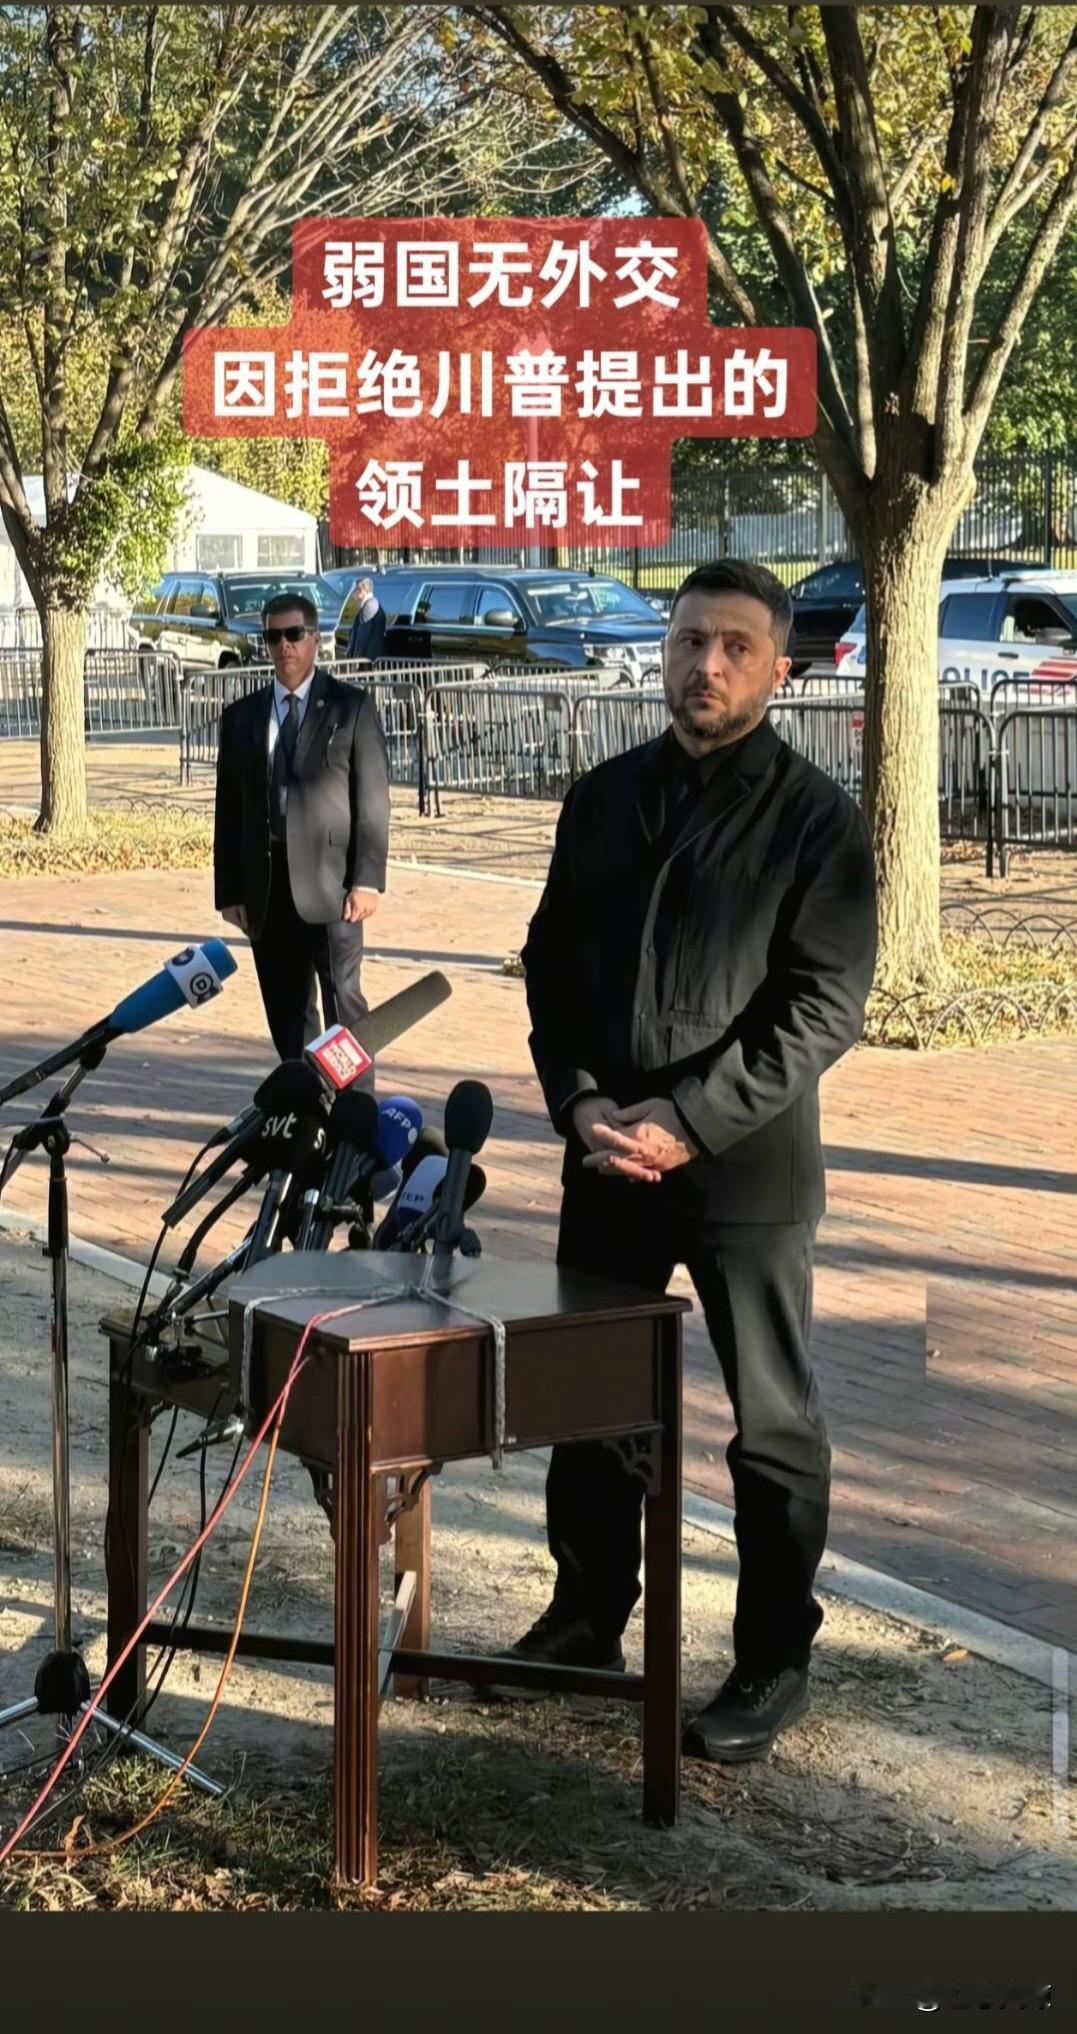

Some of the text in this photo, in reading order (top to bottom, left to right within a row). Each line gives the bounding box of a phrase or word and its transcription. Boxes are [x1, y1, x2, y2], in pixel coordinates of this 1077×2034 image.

[939, 666, 1029, 692] OLICE
[262, 1112, 297, 1138] svt
[382, 1107, 411, 1128] AFP
